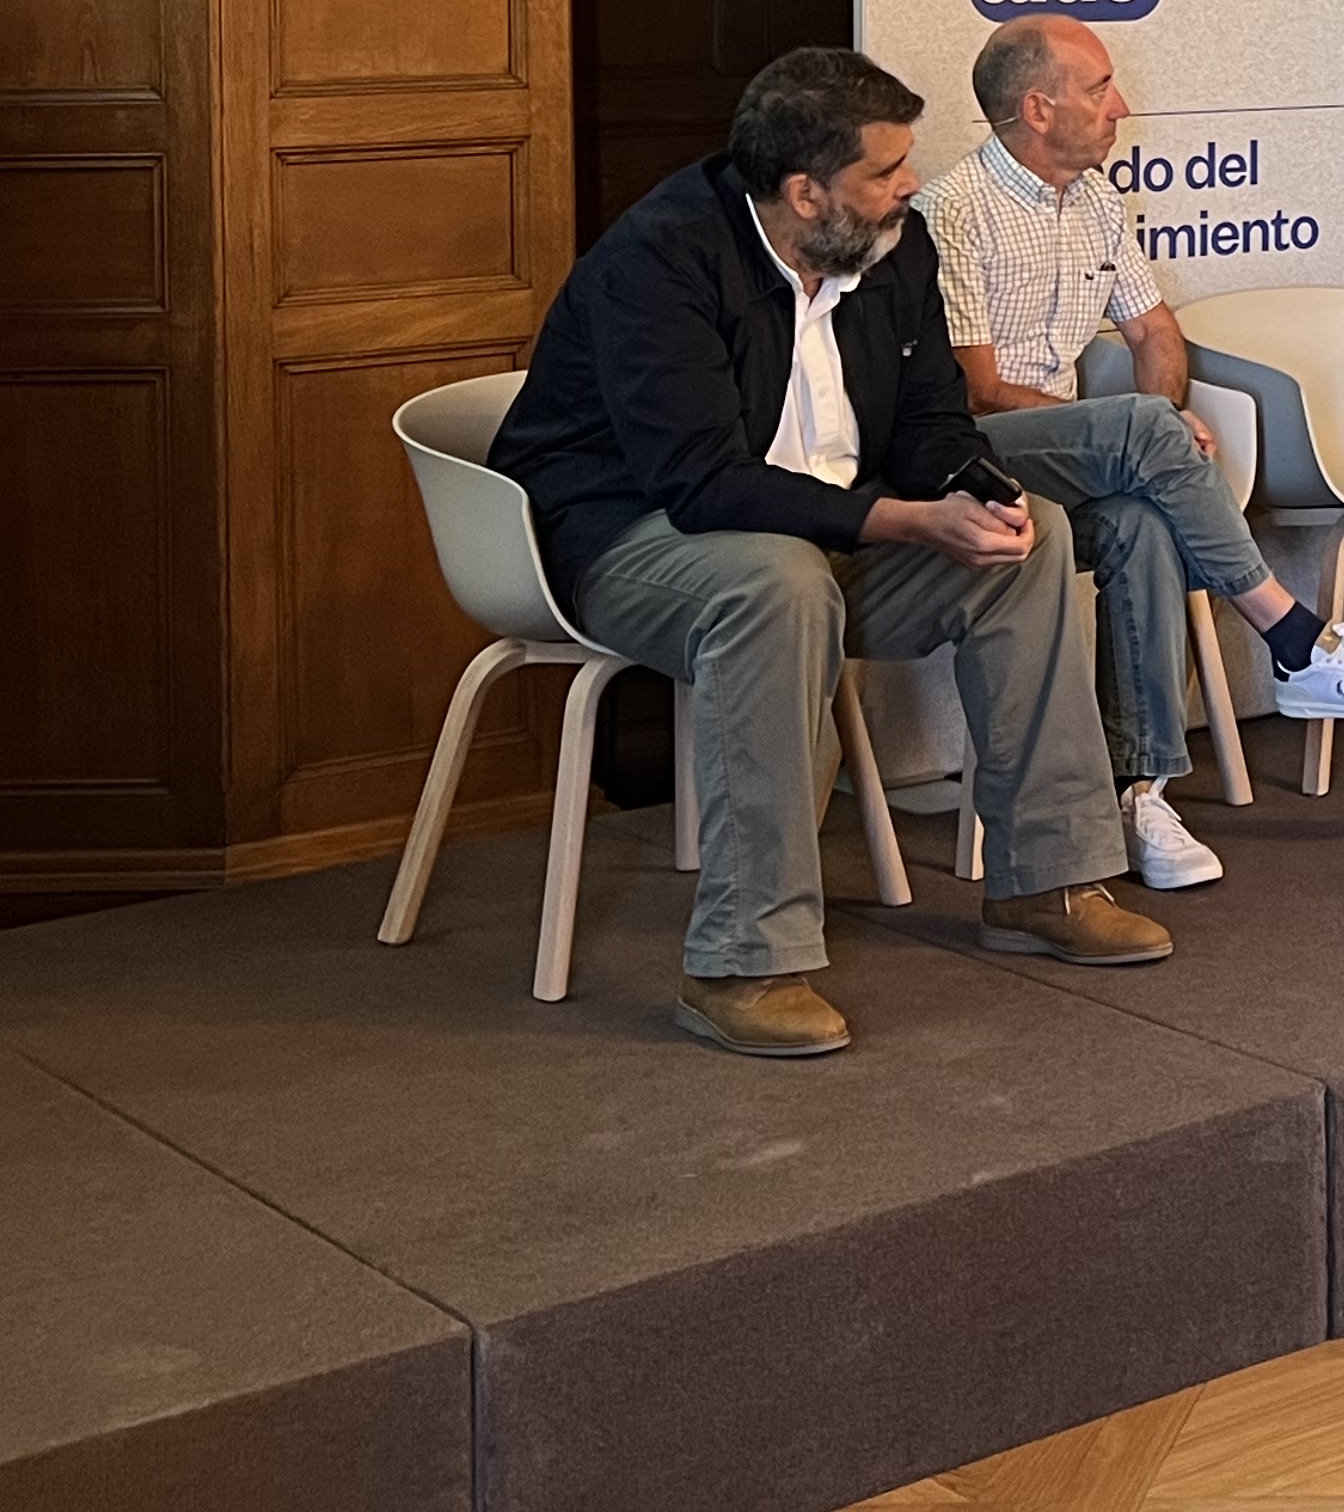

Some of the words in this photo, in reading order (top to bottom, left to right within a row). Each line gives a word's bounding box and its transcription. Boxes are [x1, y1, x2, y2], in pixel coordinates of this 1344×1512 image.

[1100, 145, 1174, 195] do
[1185, 139, 1258, 190] del
[1136, 209, 1319, 261] imiento
